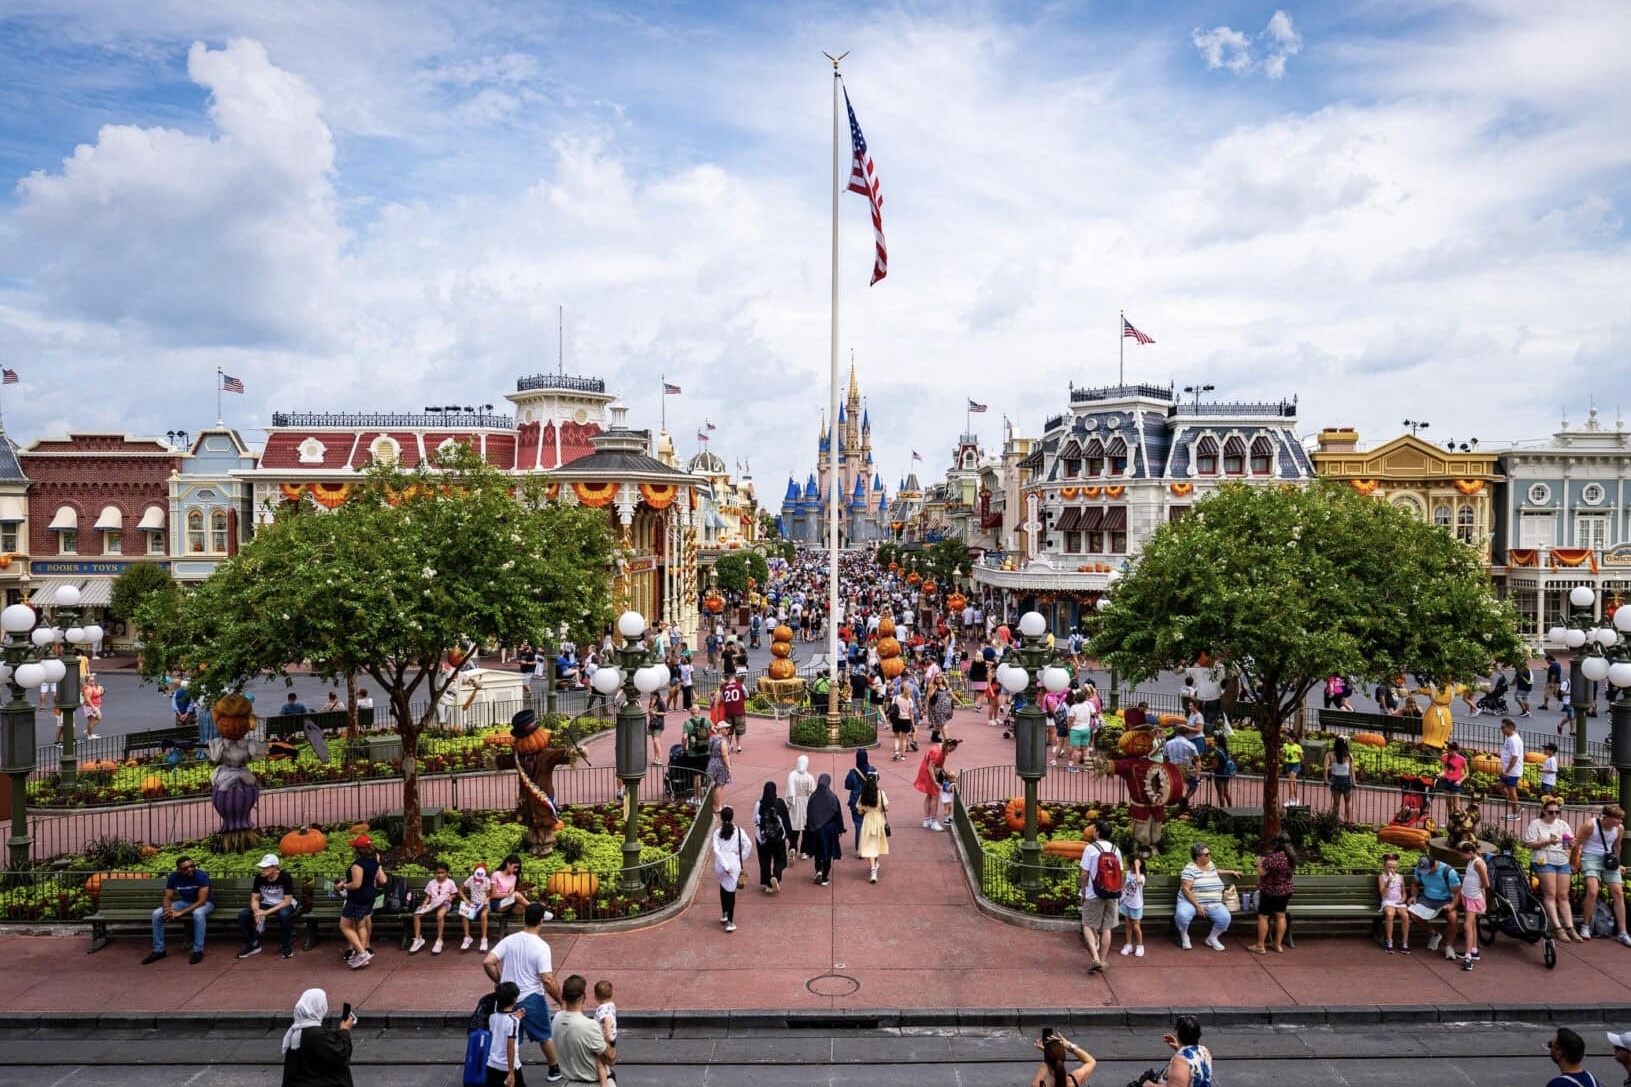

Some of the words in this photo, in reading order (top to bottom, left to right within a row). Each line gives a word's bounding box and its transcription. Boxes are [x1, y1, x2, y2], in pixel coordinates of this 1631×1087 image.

[47, 564, 79, 572] BOOKS
[92, 564, 118, 572] TOYS
[724, 689, 739, 702] 20
